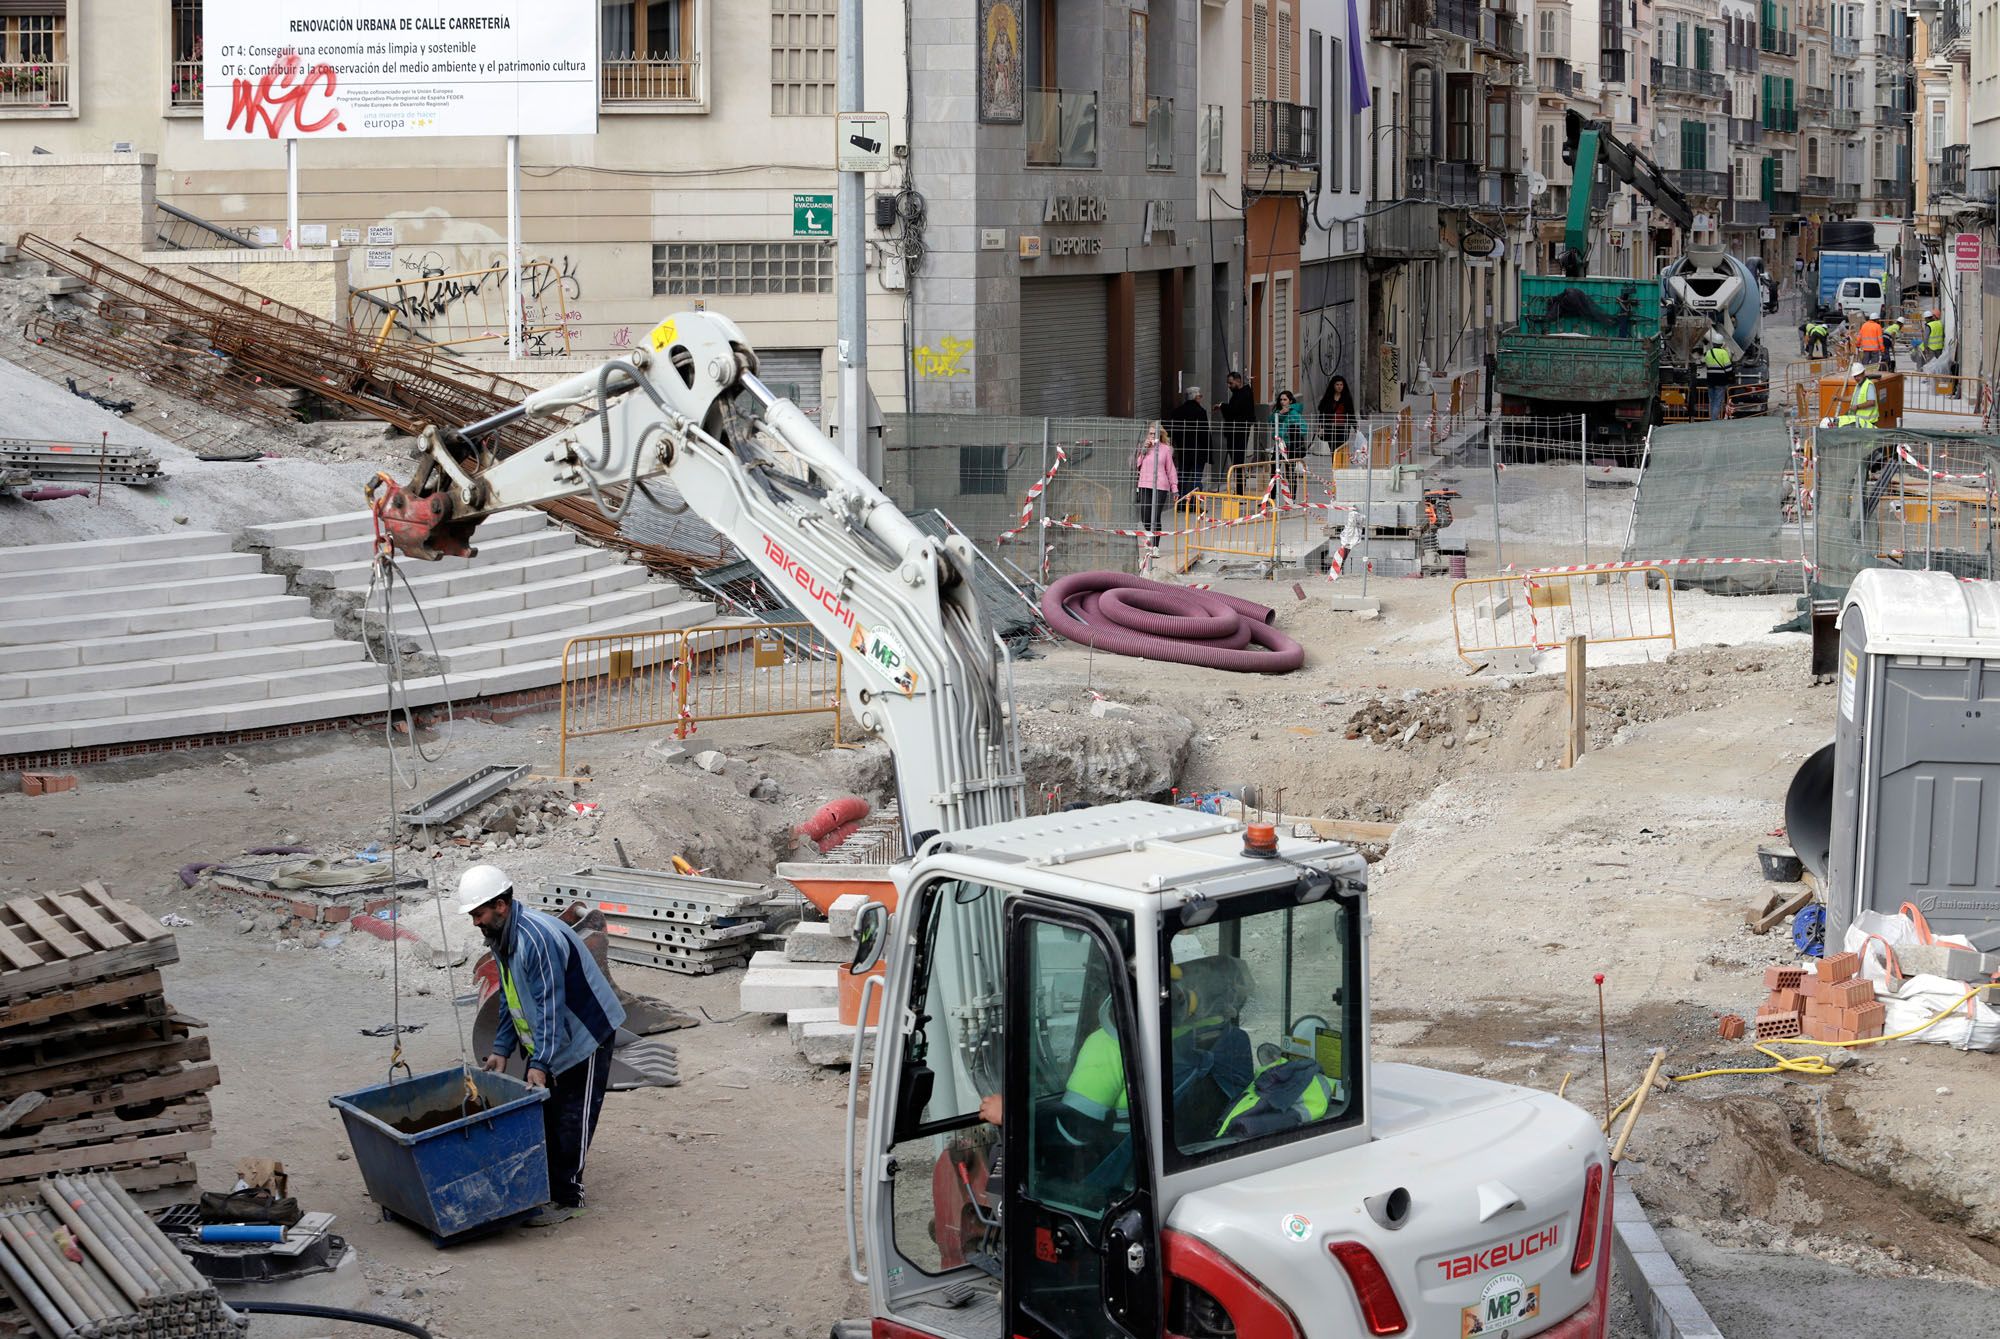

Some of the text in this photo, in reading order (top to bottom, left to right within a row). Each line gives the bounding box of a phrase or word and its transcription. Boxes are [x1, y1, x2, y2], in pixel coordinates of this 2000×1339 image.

[290, 14, 511, 32] RENOVACIÓN URBANA DE CALLE CARRETERÍA
[221, 41, 477, 58] OT 4: Conseguir una economía más limpia y sostenible
[221, 59, 586, 76] OT 6: Contribuir a la conservación del medio ambiente y el patrimonio cultura
[364, 119, 405, 129] europa
[1053, 236, 1103, 256] DEPORTES
[762, 533, 856, 629] TAKEUCHI
[1437, 1225, 1558, 1281] TAKEUCHI
